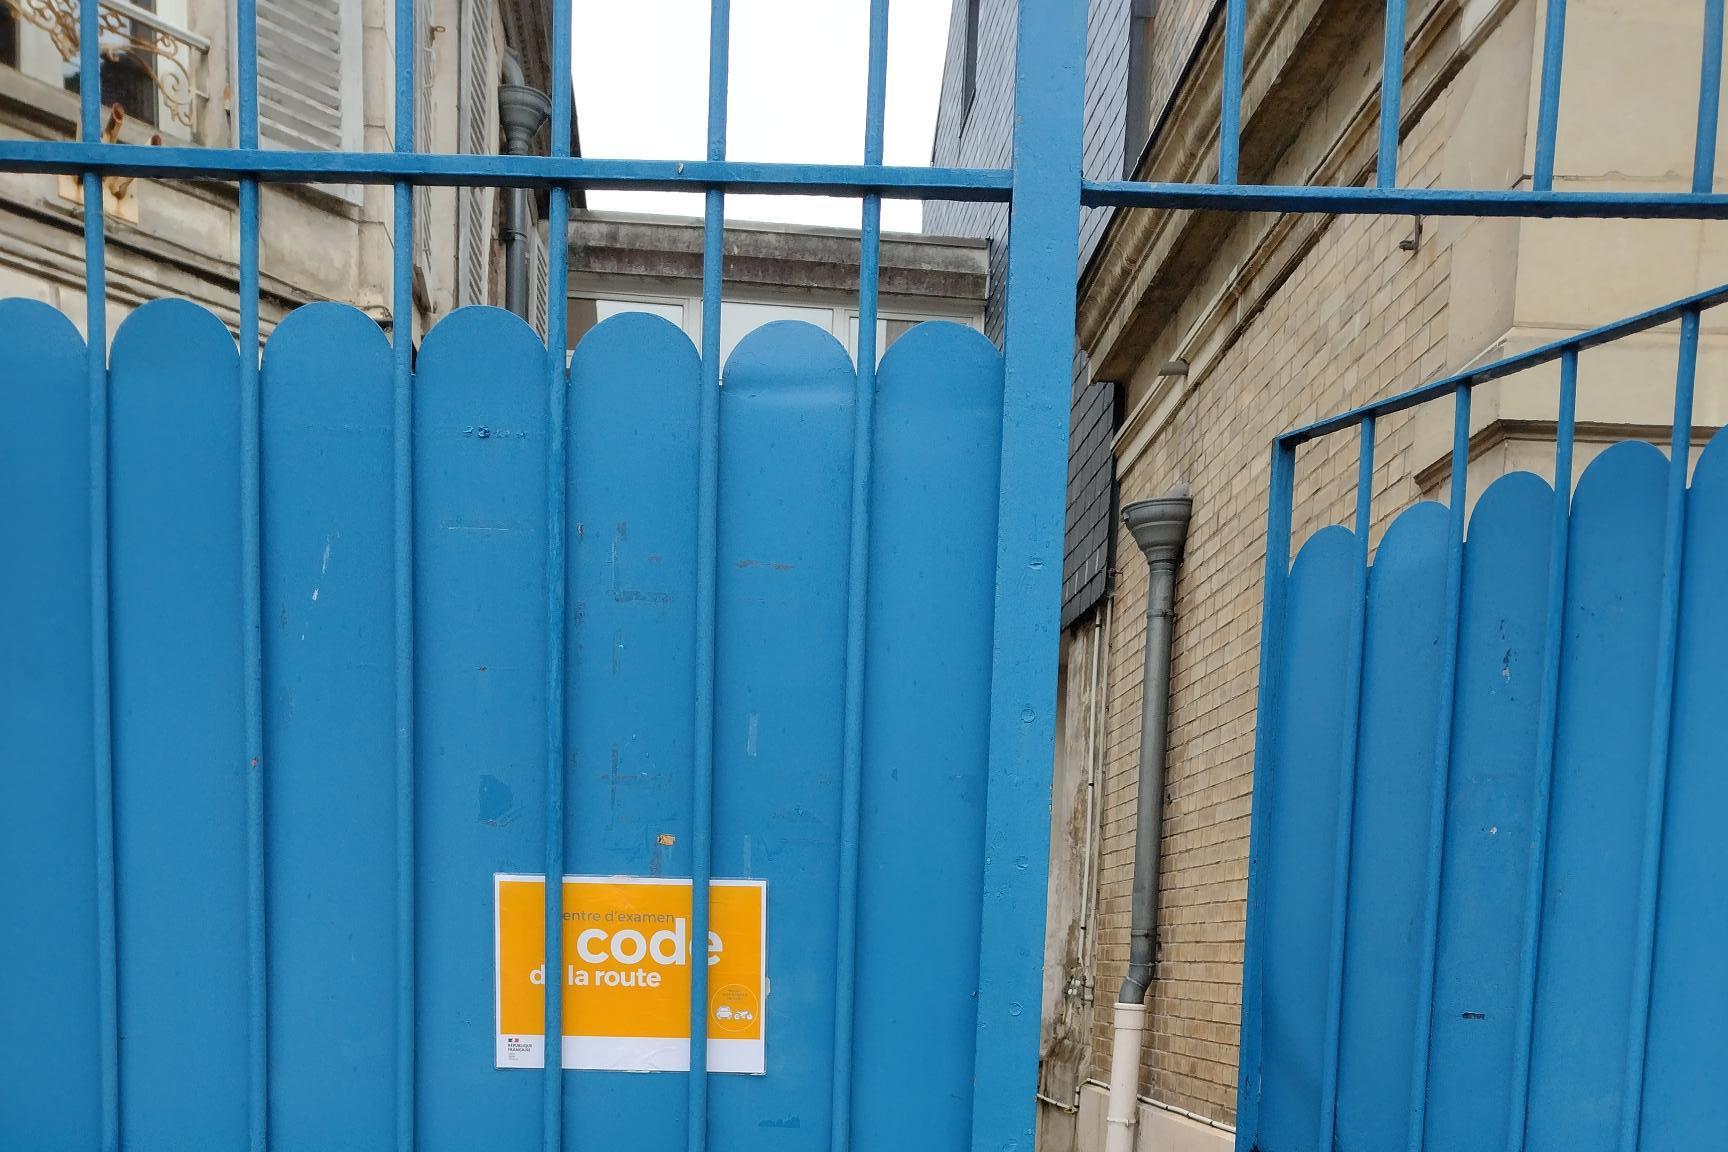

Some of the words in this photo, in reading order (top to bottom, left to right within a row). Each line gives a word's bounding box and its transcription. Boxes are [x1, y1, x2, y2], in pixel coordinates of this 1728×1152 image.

[562, 911, 601, 922] entre
[604, 910, 674, 923] d'examen
[529, 964, 546, 985] d
[568, 965, 589, 986] la
[595, 968, 662, 987] route
